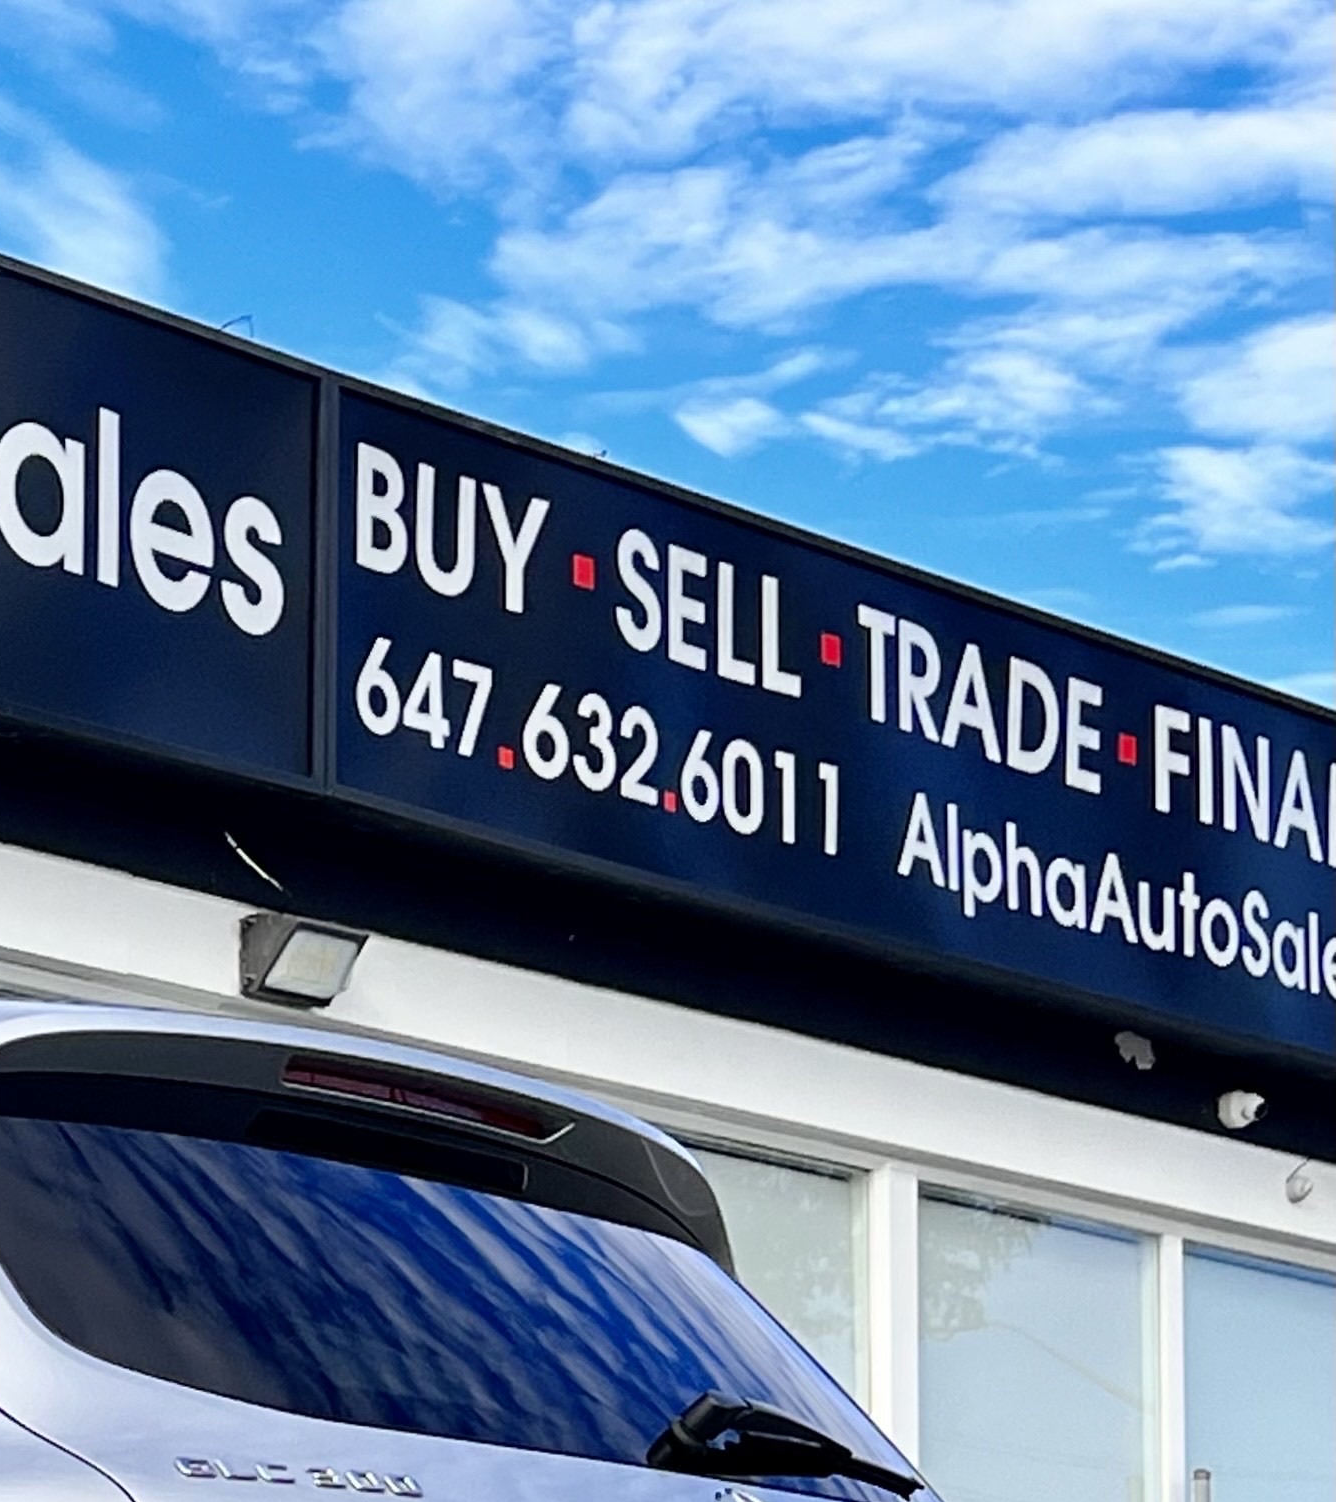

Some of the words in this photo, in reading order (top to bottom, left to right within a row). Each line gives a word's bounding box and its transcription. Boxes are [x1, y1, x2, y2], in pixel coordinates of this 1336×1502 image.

[355, 636, 839, 856] 647.632.6011
[356, 441, 550, 614] BUY
[616, 528, 802, 698] SELL
[857, 603, 1103, 794] TRADE
[1154, 704, 1336, 867] FINA
[175, 1456, 295, 1485] GLC
[305, 1468, 425, 1498] 300
